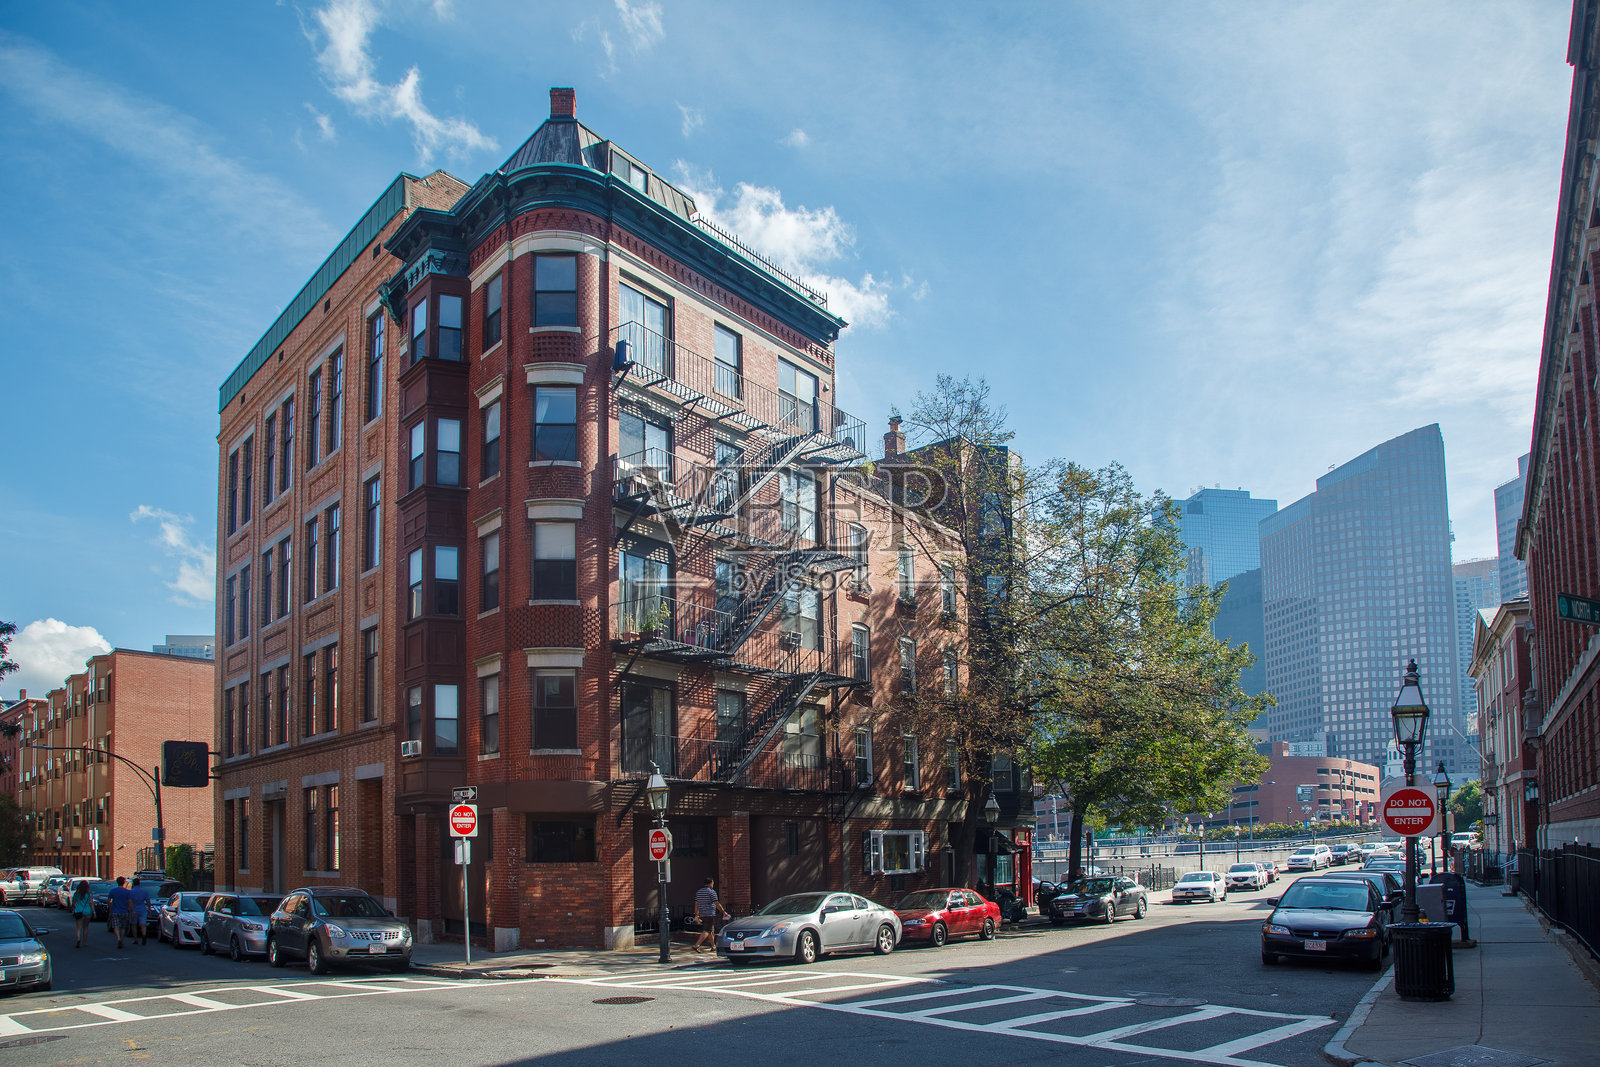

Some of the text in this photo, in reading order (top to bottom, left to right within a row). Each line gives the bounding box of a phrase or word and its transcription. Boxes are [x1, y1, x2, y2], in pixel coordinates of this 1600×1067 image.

[1571, 600, 1590, 620] NORTH
[1390, 799, 1427, 807] DO NOT
[1394, 817, 1424, 825] ENTER
